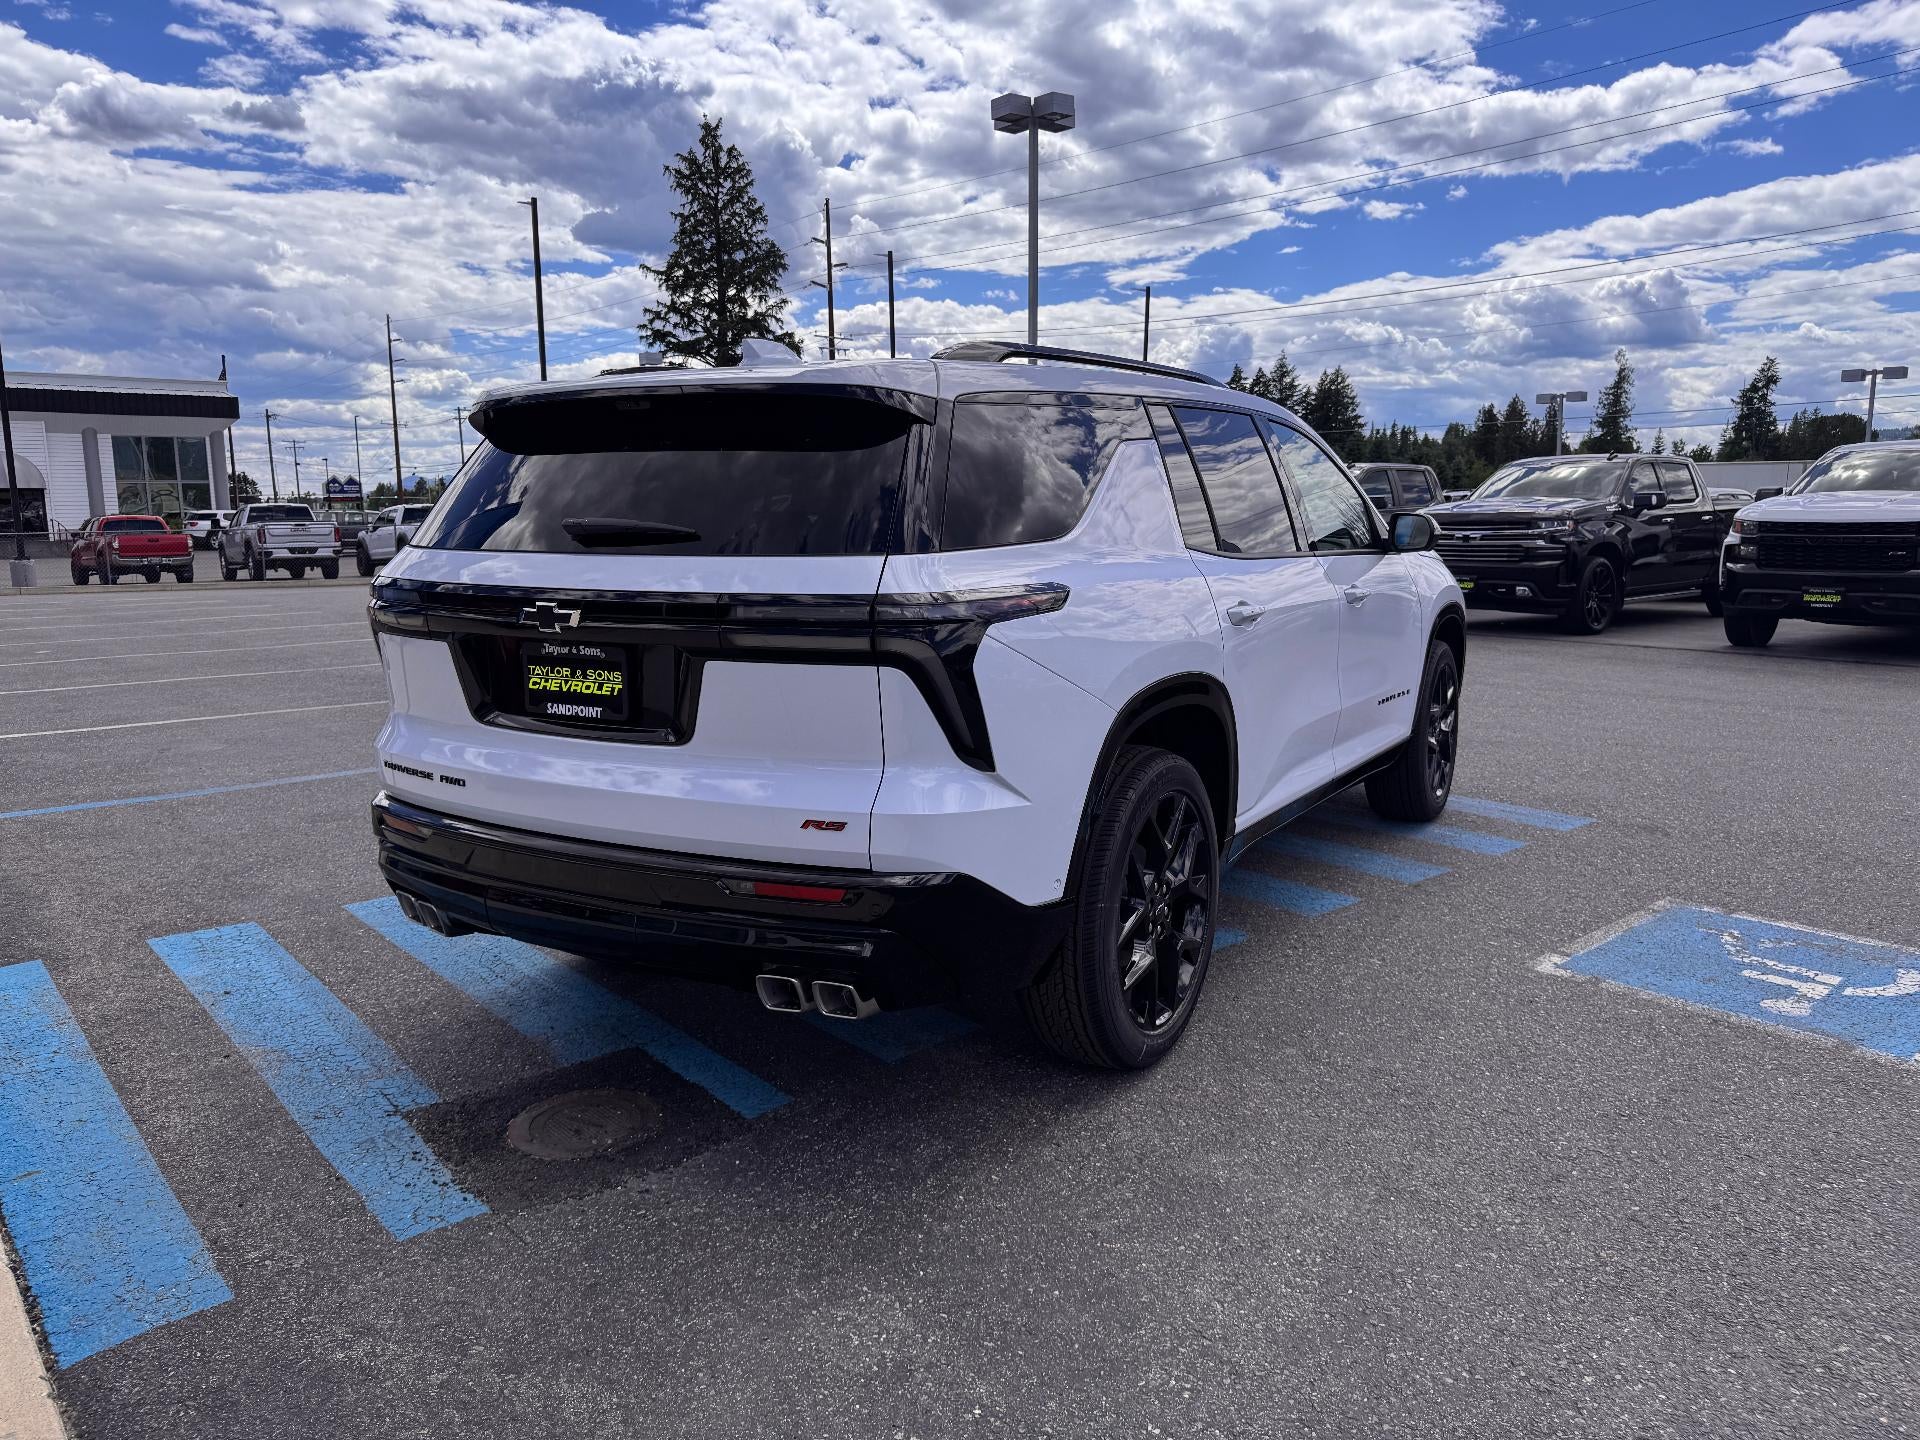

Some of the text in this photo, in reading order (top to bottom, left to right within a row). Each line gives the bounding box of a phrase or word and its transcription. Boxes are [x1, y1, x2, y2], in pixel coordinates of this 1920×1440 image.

[543, 643, 601, 656] Taylor & Sons
[528, 665, 622, 682] TAYLOR & SONS
[528, 677, 623, 696] CHEVROLET
[546, 702, 603, 719] SANDPOINT
[383, 760, 434, 781] TRAVERSE
[799, 819, 848, 832] RS
